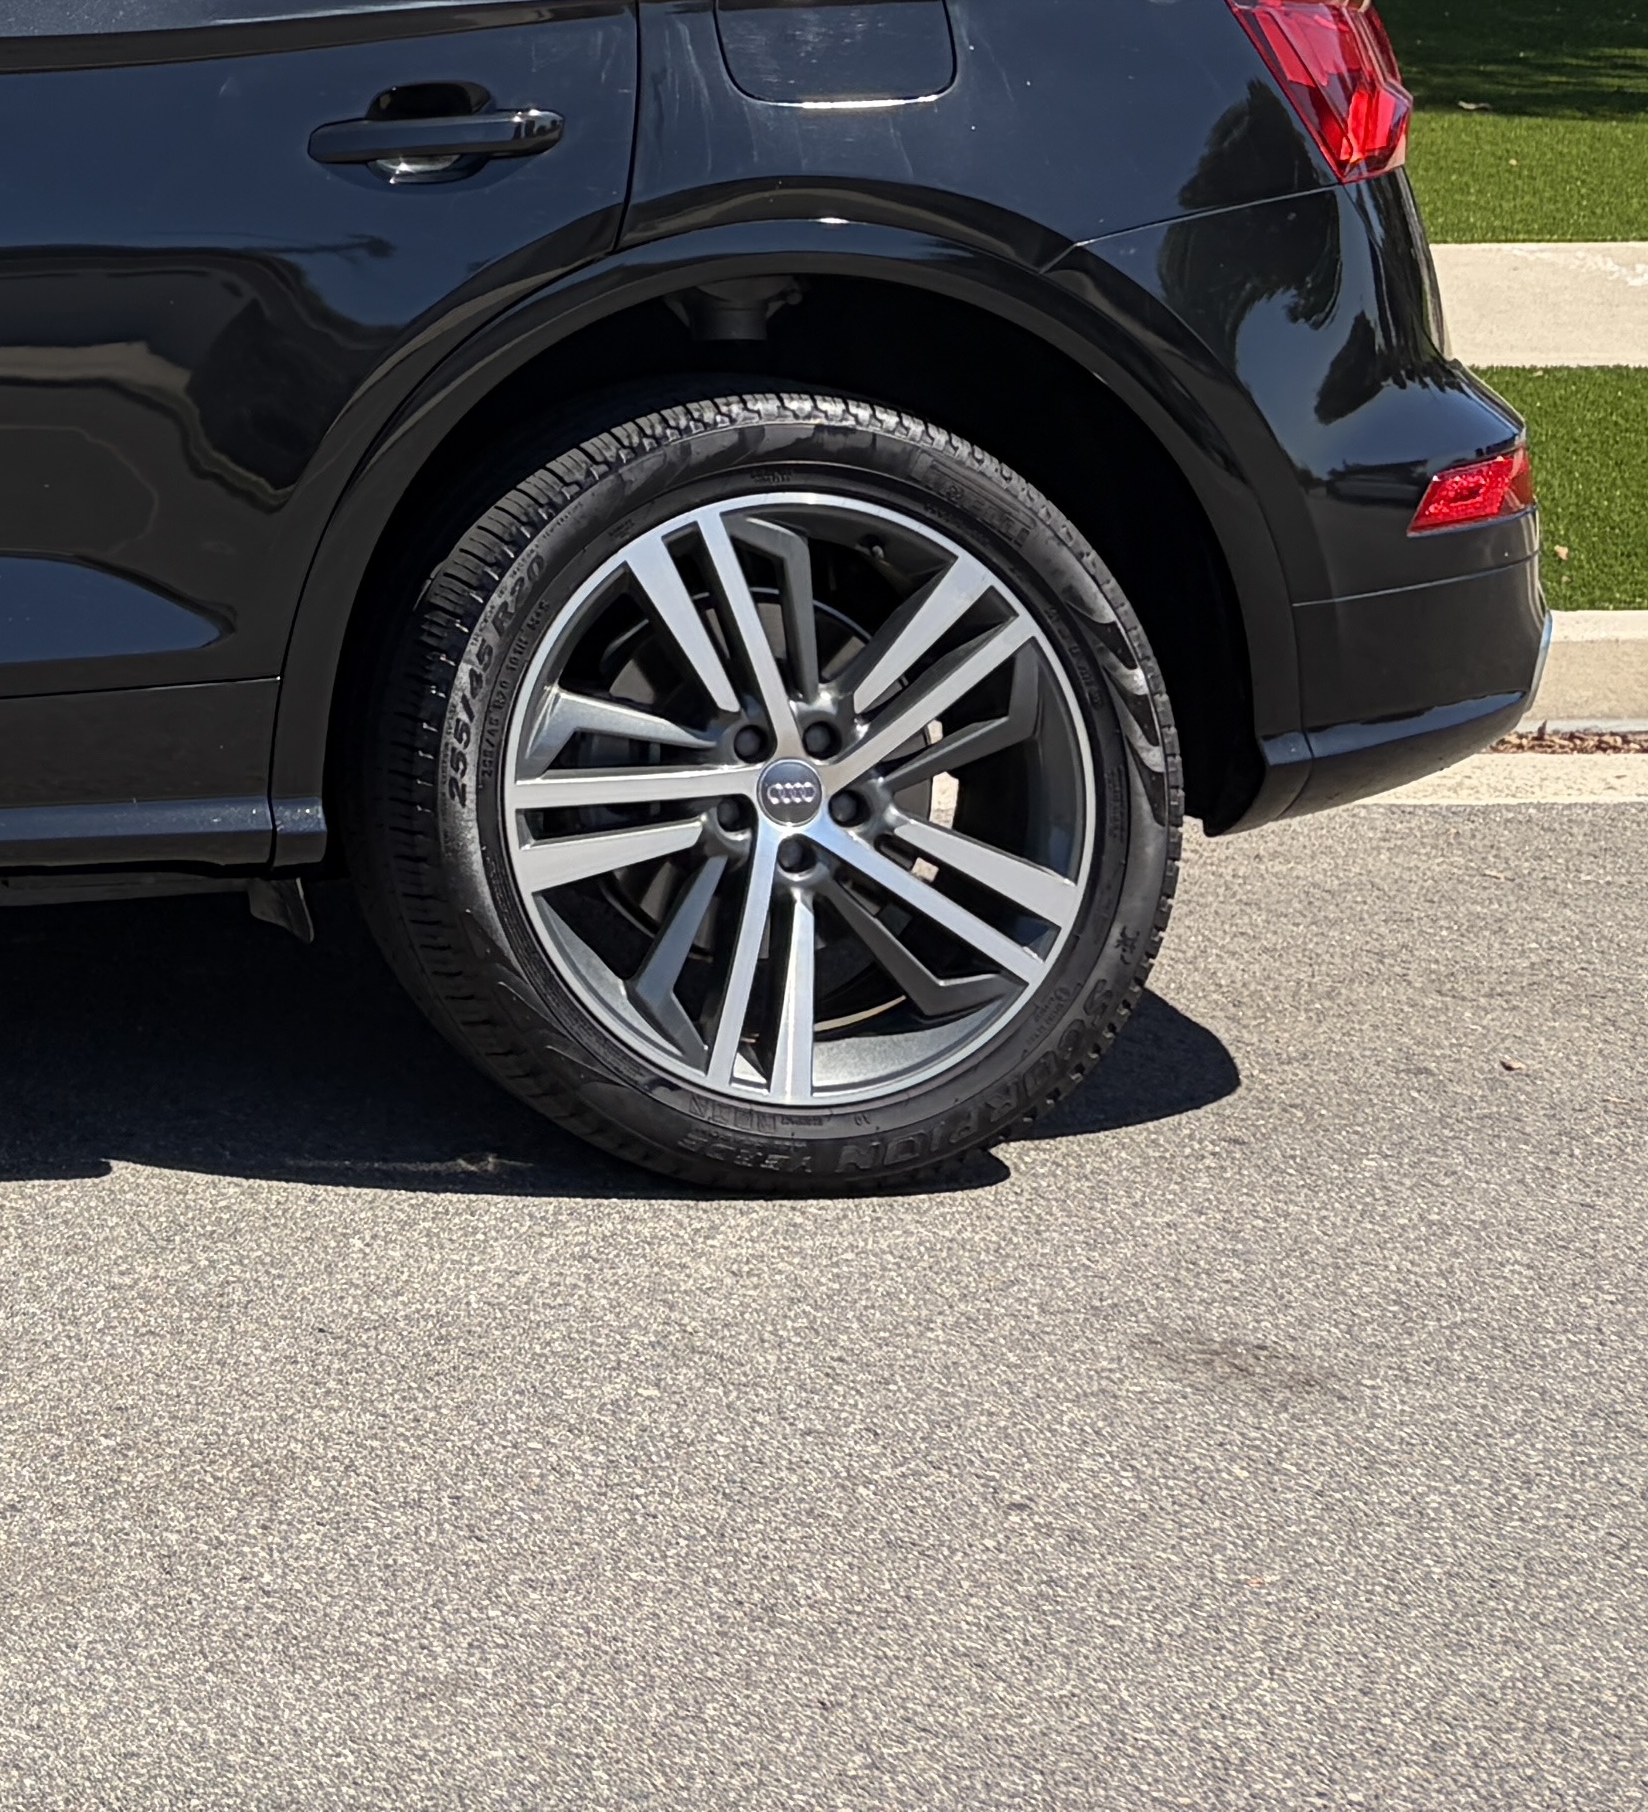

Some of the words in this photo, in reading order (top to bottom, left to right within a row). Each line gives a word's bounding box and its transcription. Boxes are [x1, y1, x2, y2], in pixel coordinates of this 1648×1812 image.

[448, 638, 494, 809] 255/45
[491, 552, 548, 638] R20
[836, 978, 1111, 1174] SCORPION
